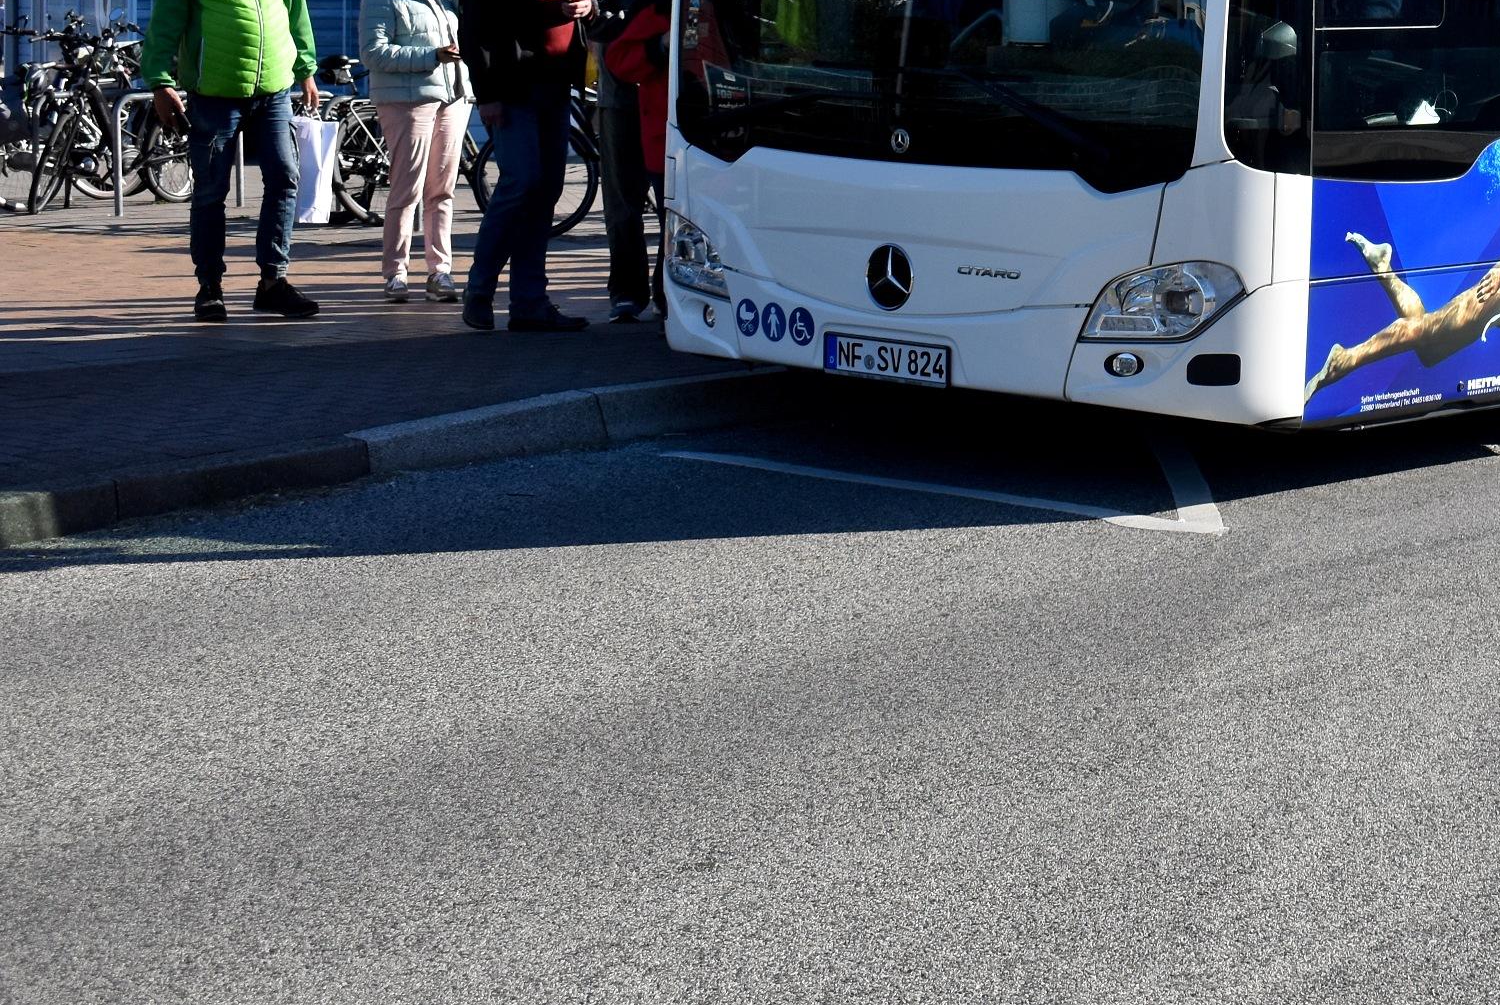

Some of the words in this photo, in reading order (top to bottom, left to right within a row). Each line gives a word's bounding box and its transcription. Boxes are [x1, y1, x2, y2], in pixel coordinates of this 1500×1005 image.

[957, 264, 1022, 280] CITARO
[838, 340, 863, 367] NF
[877, 345, 902, 373] SV
[907, 349, 945, 378] 824
